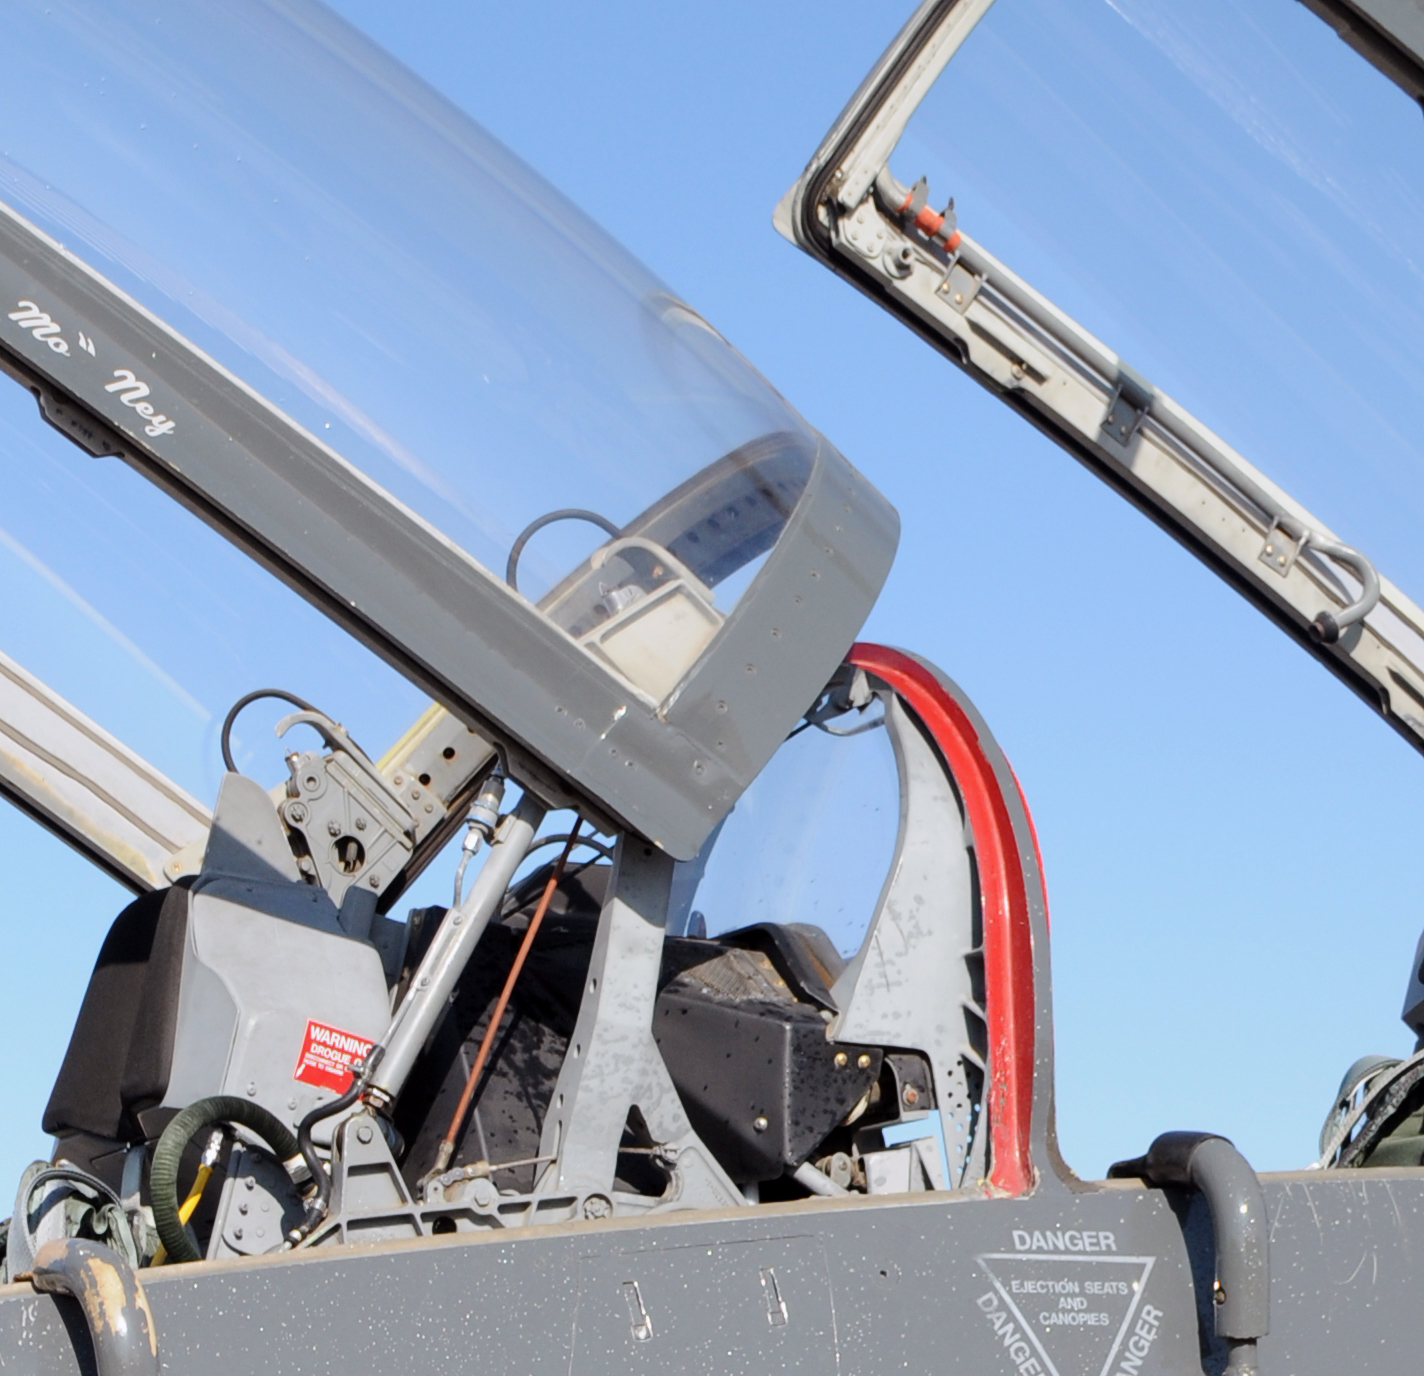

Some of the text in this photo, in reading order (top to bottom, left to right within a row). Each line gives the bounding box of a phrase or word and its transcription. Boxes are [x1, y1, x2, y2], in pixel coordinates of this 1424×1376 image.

[104, 369, 174, 438] Ney
[310, 1042, 352, 1065] DROGUE
[1012, 1230, 1117, 1251] DANGER
[1011, 1280, 1128, 1295] EJECTION SEATS
[1058, 1297, 1087, 1310] AND
[1039, 1312, 1110, 1326] CANOPIES
